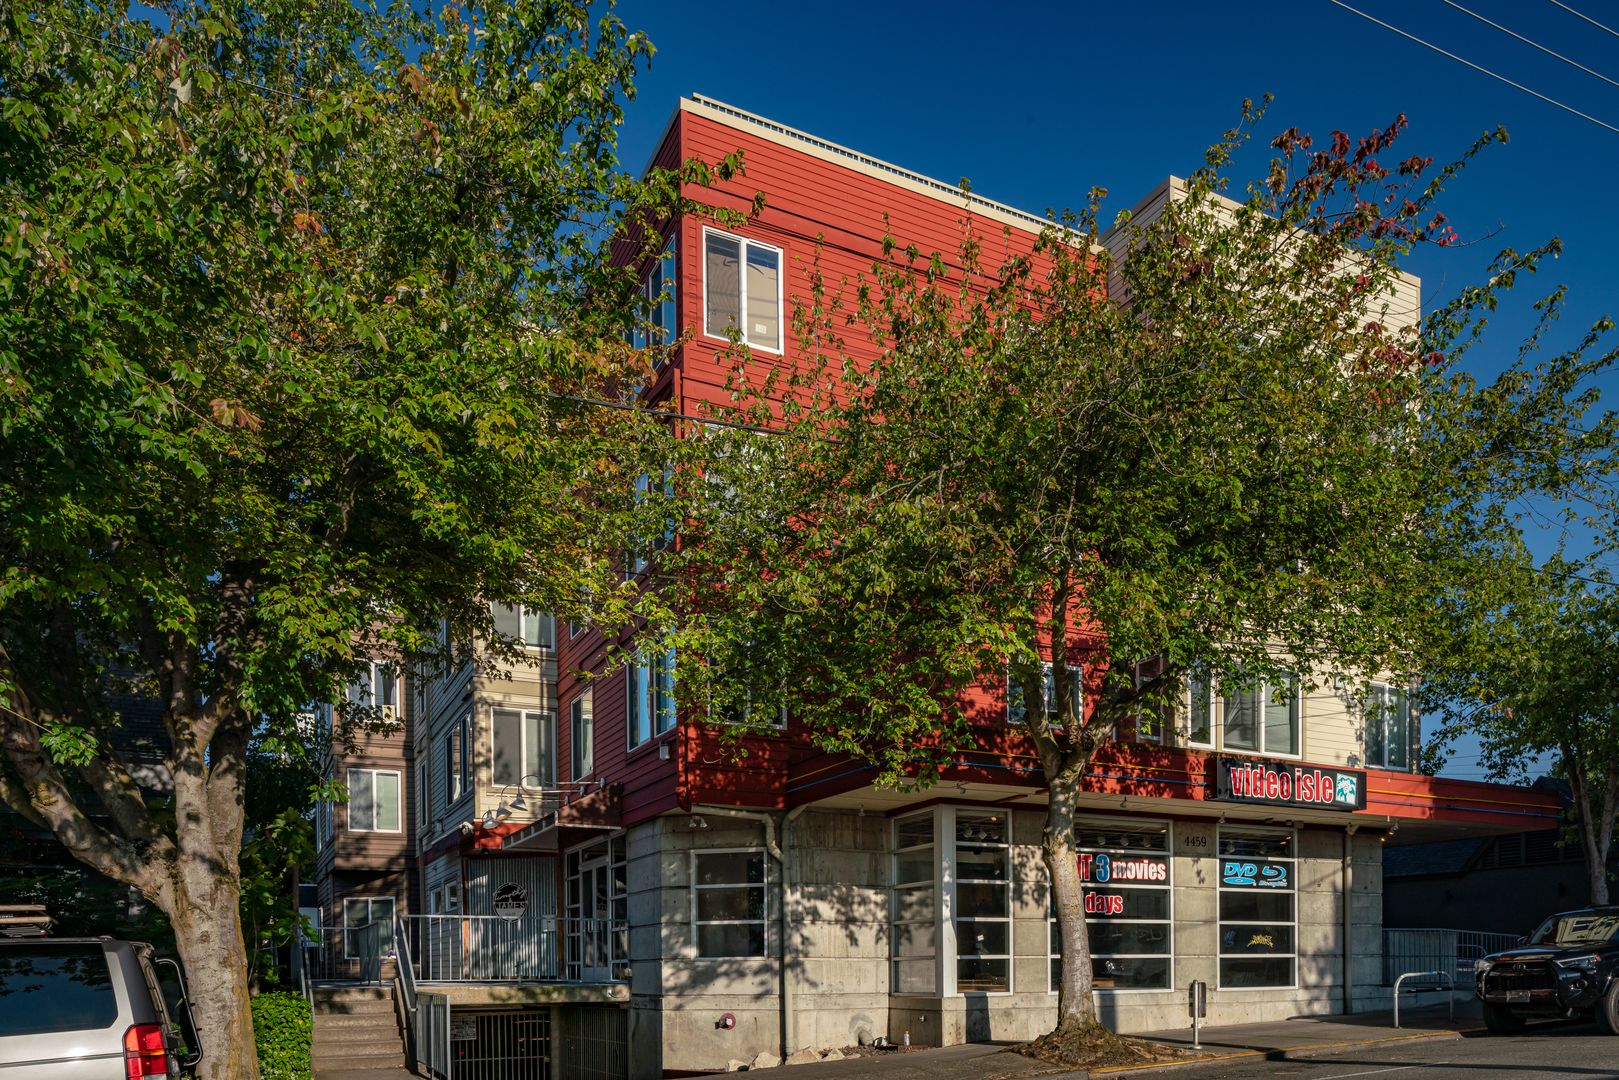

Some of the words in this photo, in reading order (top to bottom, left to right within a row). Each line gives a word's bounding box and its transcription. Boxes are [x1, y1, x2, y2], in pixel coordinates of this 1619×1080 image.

[1231, 763, 1291, 800] video
[1295, 768, 1334, 804] isle
[1184, 835, 1207, 848] 4459
[1095, 854, 1110, 882] 3
[1112, 860, 1166, 881] movies
[1224, 862, 1257, 877] DVD
[1085, 892, 1123, 915] days
